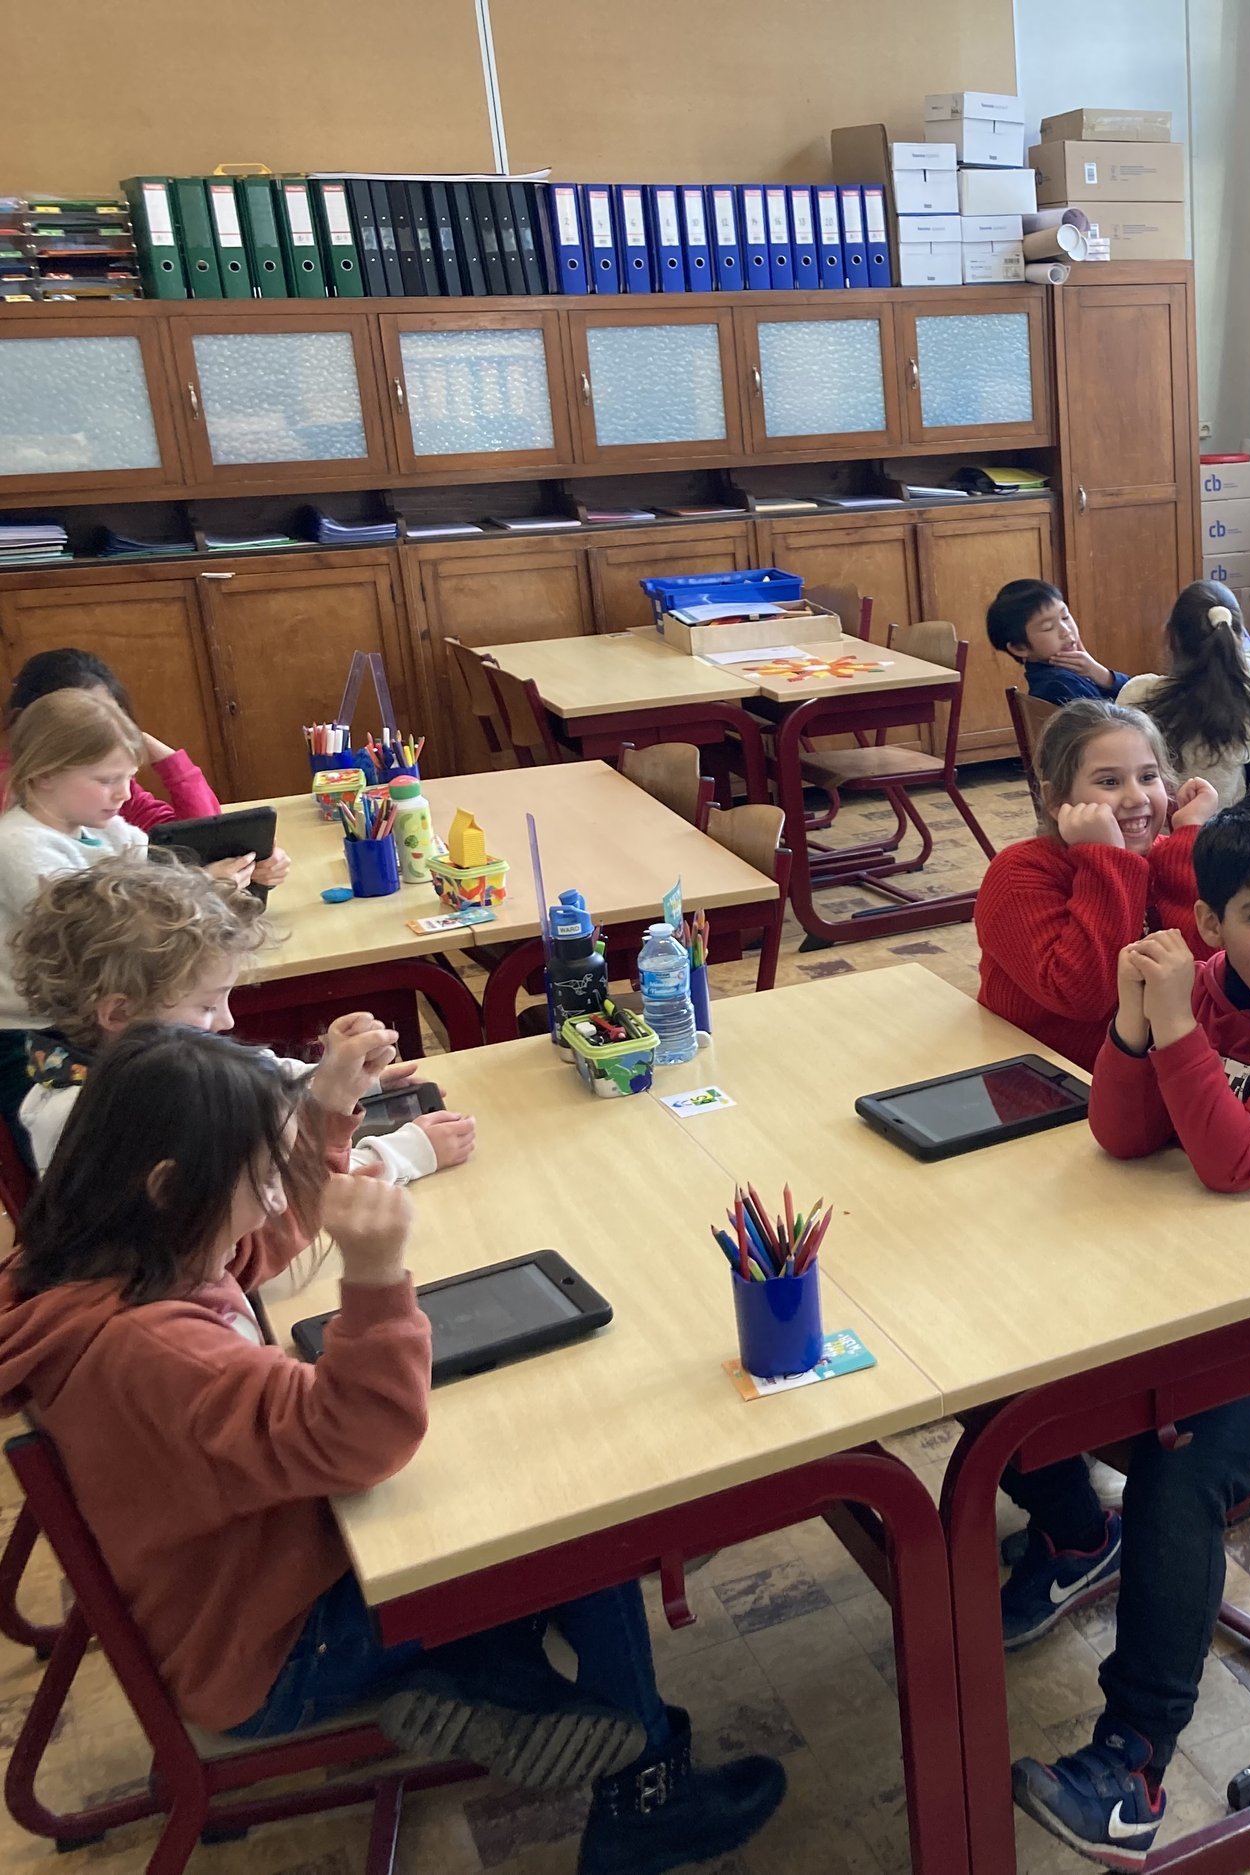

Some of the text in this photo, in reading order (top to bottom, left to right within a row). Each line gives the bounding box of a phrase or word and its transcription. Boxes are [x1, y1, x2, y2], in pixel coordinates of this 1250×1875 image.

[1204, 474, 1222, 492] cb
[1208, 520, 1226, 538] cb
[1210, 564, 1227, 581] cb
[559, 925, 580, 934] WARD
